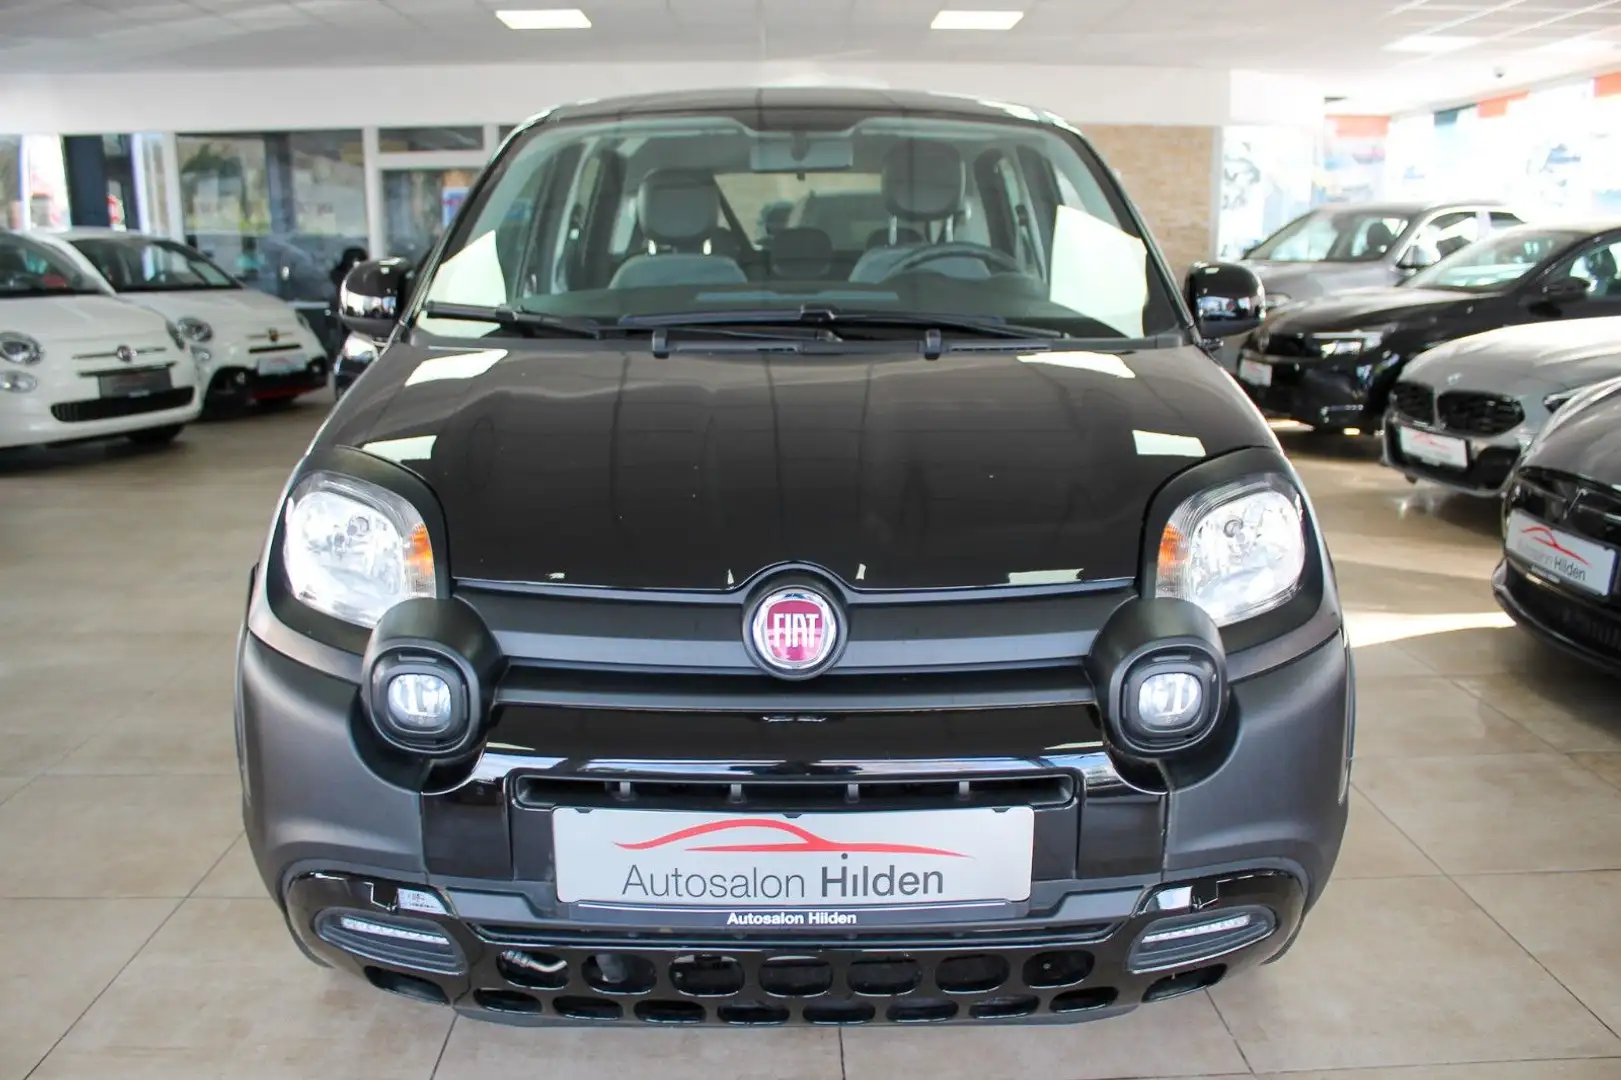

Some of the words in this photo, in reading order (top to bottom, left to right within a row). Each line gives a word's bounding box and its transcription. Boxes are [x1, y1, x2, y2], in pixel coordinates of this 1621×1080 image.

[773, 612, 820, 648] FIAT
[622, 864, 805, 899] Autosalon
[821, 852, 944, 898] Hilden
[727, 911, 804, 925] Autosalon
[808, 911, 857, 925] Hilden
